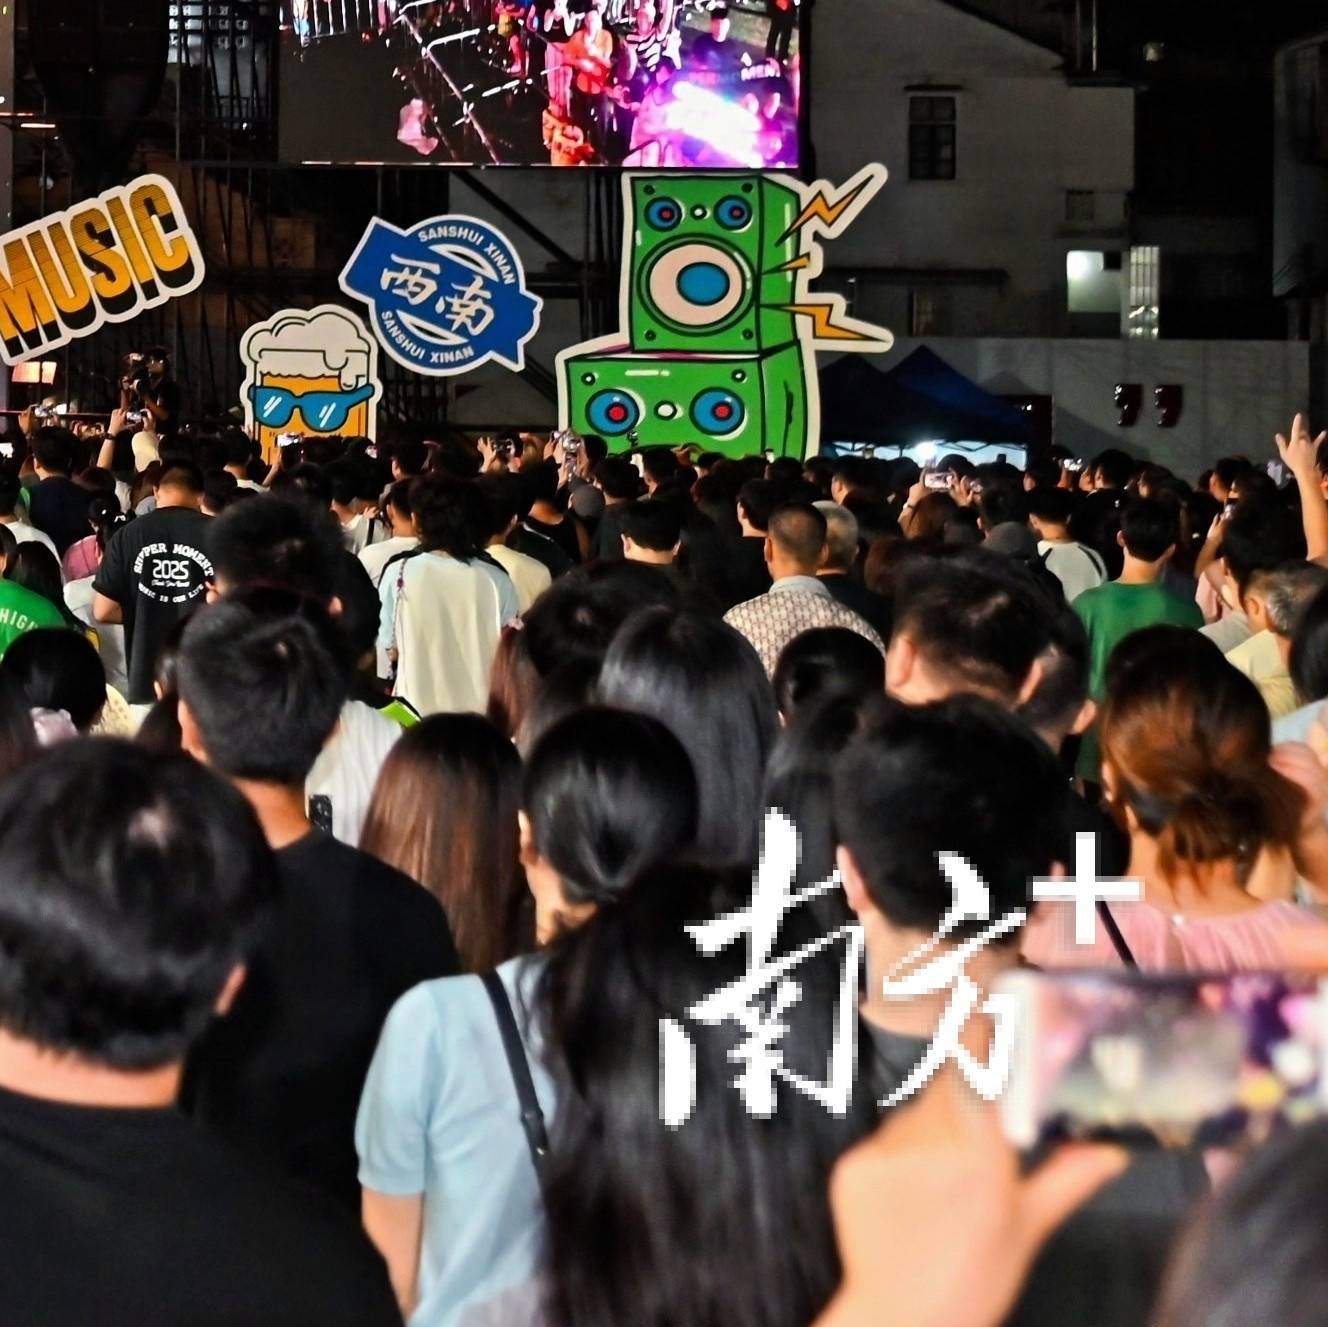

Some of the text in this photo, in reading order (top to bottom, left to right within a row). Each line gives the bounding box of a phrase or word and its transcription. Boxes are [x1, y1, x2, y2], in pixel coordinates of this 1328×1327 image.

[418, 225, 516, 285] SANSHUI XINAN
[380, 253, 494, 336] 西南
[381, 311, 474, 364] SANSHUI XINAN
[152, 559, 190, 580] 2025
[172, 544, 214, 577] MOMENT
